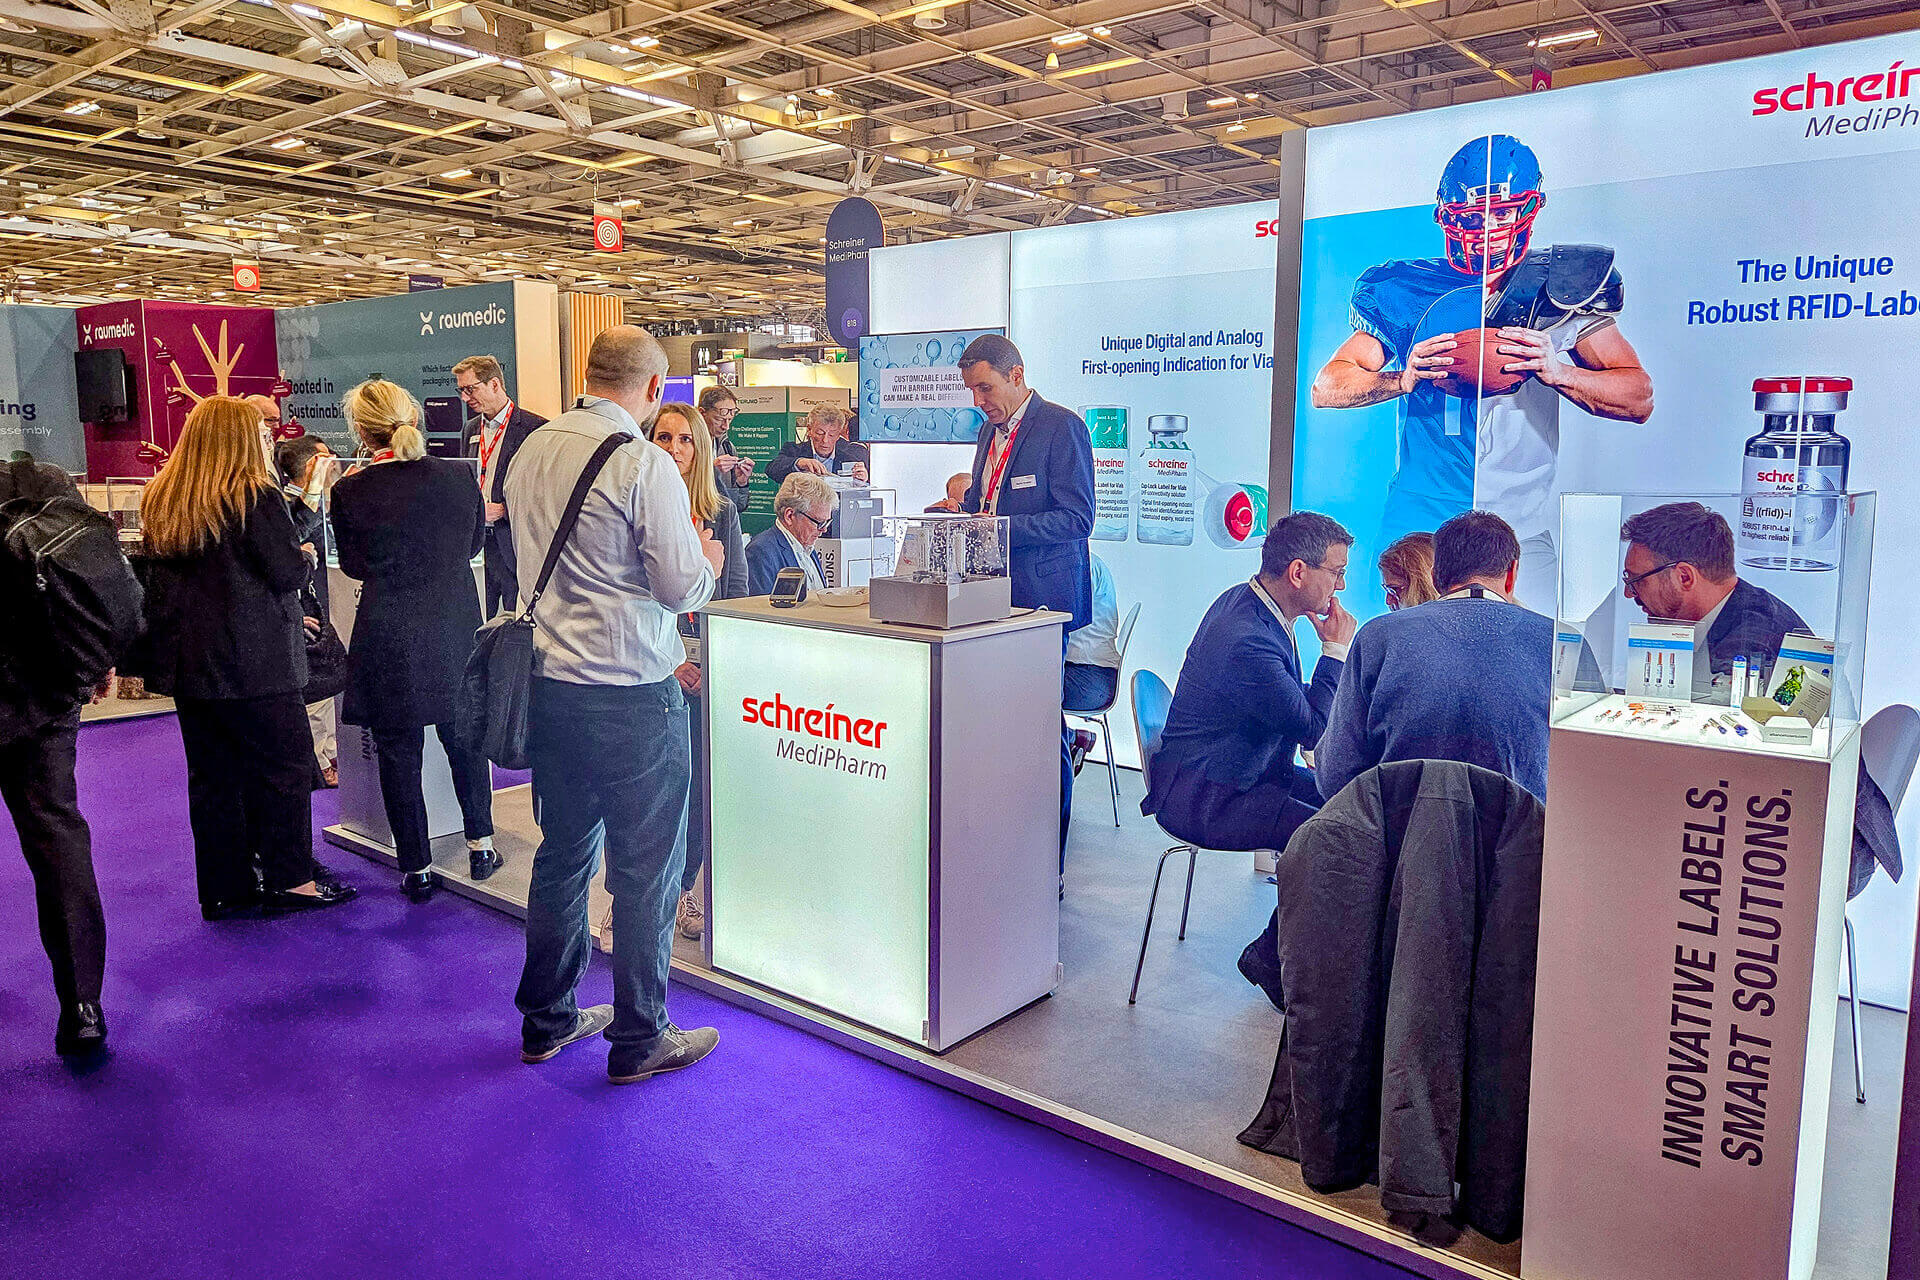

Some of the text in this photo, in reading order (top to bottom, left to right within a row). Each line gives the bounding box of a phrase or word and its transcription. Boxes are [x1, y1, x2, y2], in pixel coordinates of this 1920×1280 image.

[829, 238, 865, 250] Schreiner
[1737, 254, 1894, 284] The Unique
[438, 302, 507, 330] raumedic
[1687, 297, 1780, 325] Robust
[94, 318, 136, 340] raumedic
[1101, 328, 1264, 353] Unique Digital and Analog
[1082, 357, 1161, 377] First-opening
[1163, 353, 1227, 373] Indication
[1229, 353, 1250, 370] for
[324, 377, 334, 394] in
[891, 384, 907, 393] WITH
[908, 383, 934, 392] BARRIER
[894, 373, 939, 383] CUSTOMIZABLE
[883, 394, 896, 402] CAN
[896, 394, 913, 402] MAKE
[915, 394, 920, 402] A
[921, 393, 936, 402] REAL
[1148, 458, 1188, 469] schreiner
[1157, 469, 1188, 477] MediPharm
[1747, 531, 1767, 540] highest
[742, 692, 888, 749] schreiner
[776, 737, 887, 780] MediPharm
[1732, 787, 1793, 1017] SOLUTIONS.
[1661, 779, 1730, 1169] INNOVATIVE LABELS.
[1720, 1023, 1773, 1167] SMART
